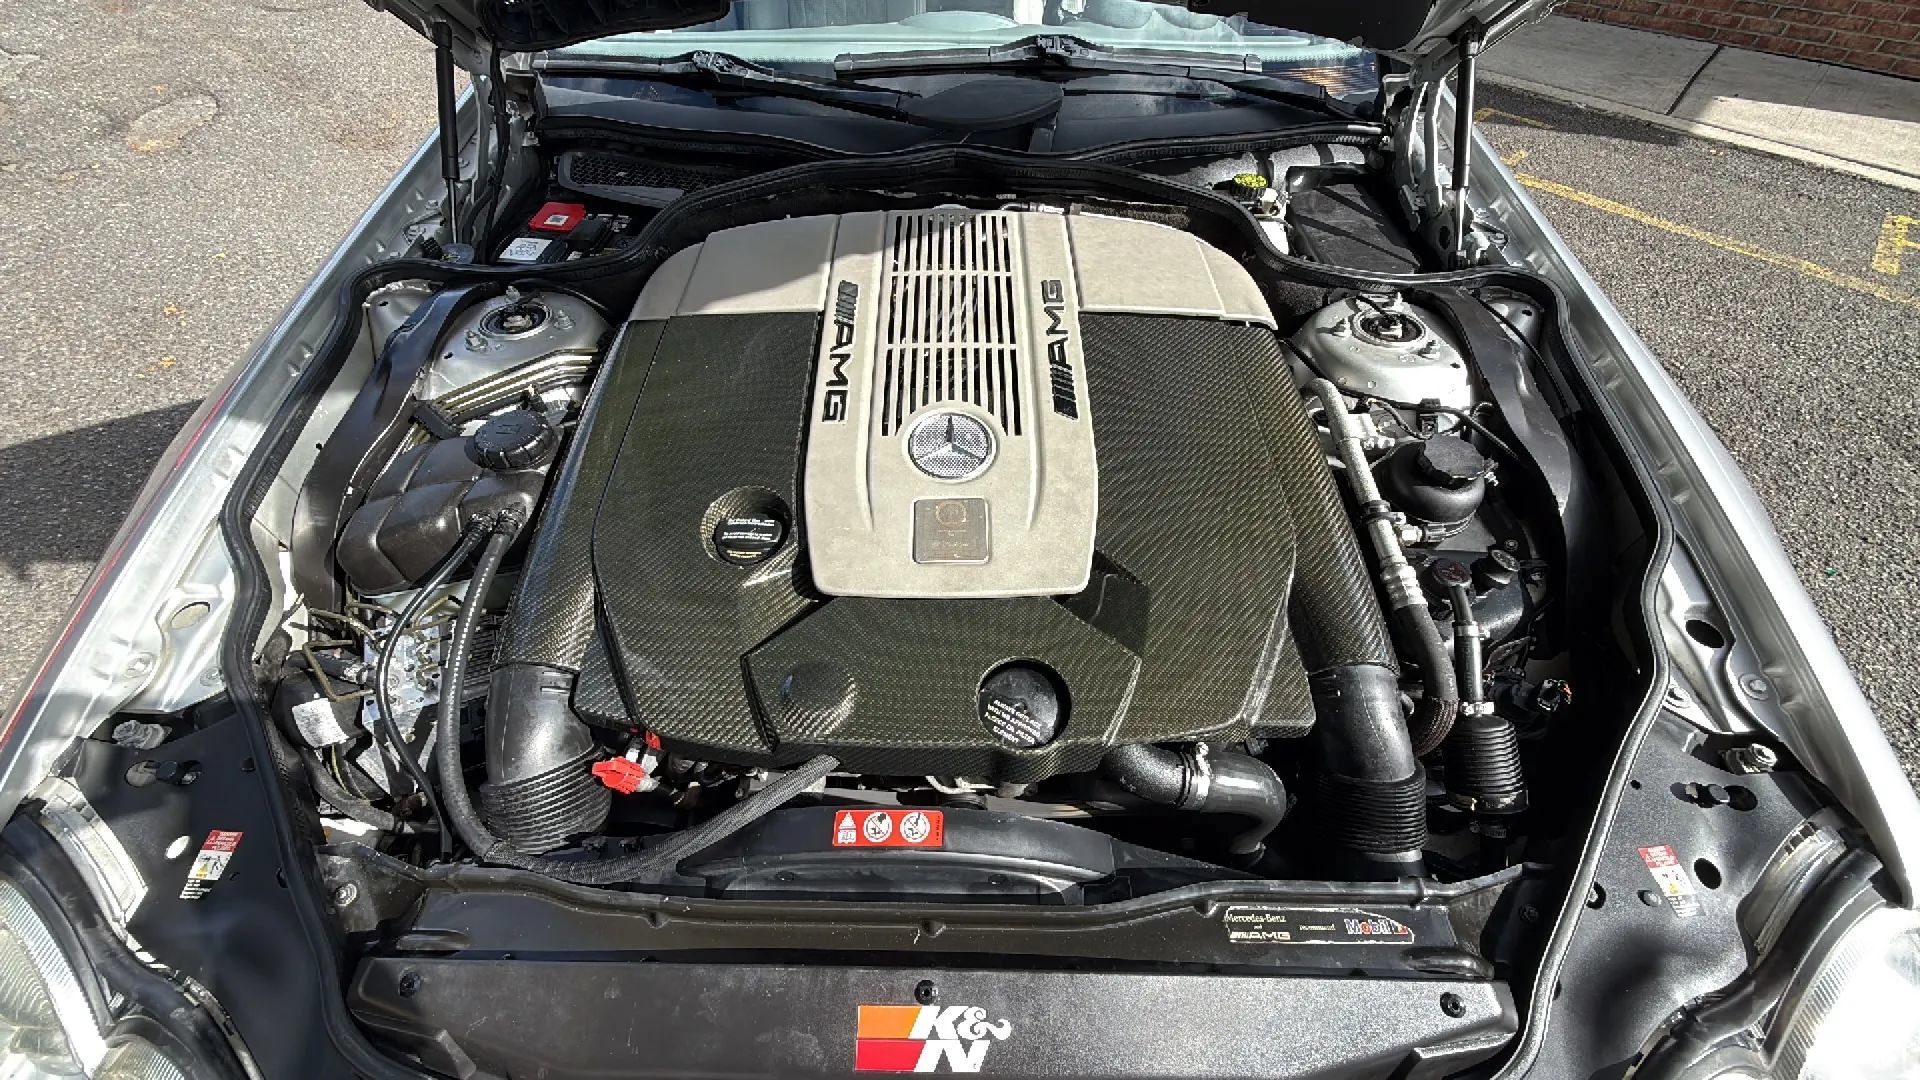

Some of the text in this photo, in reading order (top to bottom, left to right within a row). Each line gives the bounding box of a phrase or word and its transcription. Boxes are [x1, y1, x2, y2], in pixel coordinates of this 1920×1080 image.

[1041, 279, 1072, 372] AMG
[822, 316, 855, 422] AMG
[1222, 913, 1287, 923] Mercedes-Benz
[1343, 918, 1393, 935] Mobil
[1248, 931, 1291, 940] AMG
